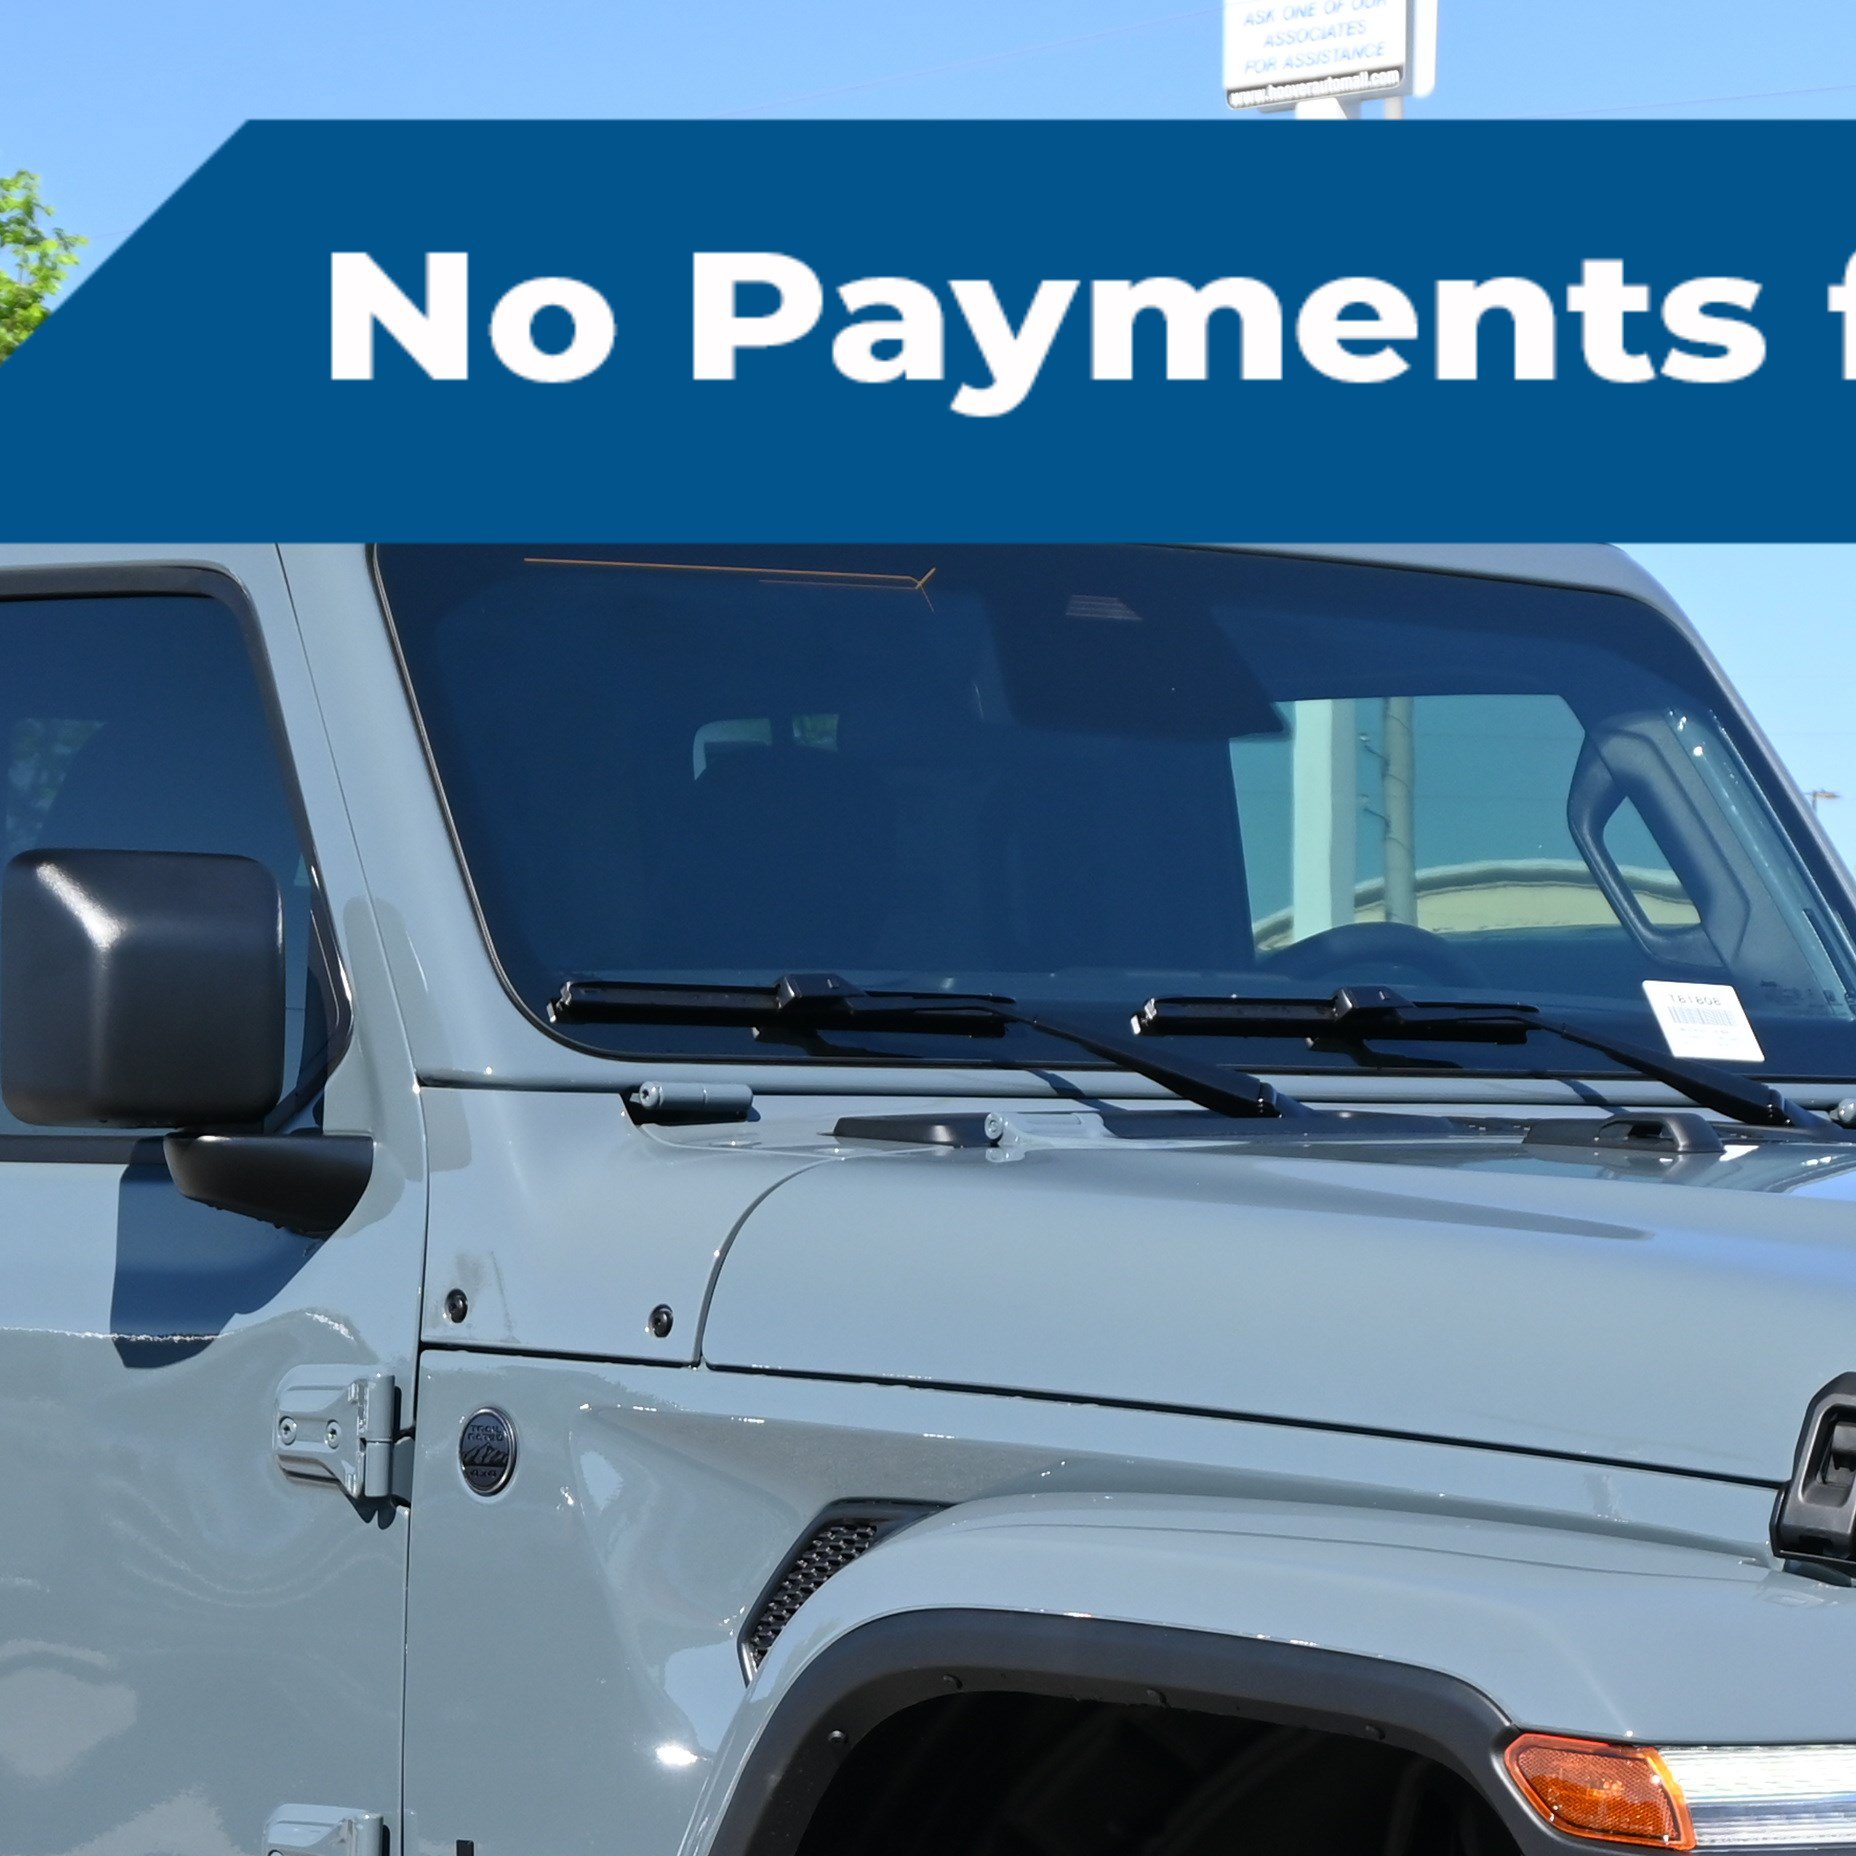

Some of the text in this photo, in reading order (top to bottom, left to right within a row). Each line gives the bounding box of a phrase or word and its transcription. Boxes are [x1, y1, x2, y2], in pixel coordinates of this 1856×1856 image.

[1243, 10, 1275, 27] ASK
[1282, 3, 1315, 21] ONE
[1324, 0, 1344, 15] OF
[1264, 20, 1367, 48] ASSOCIATES
[1245, 41, 1386, 75] FOR ASSISTANCE
